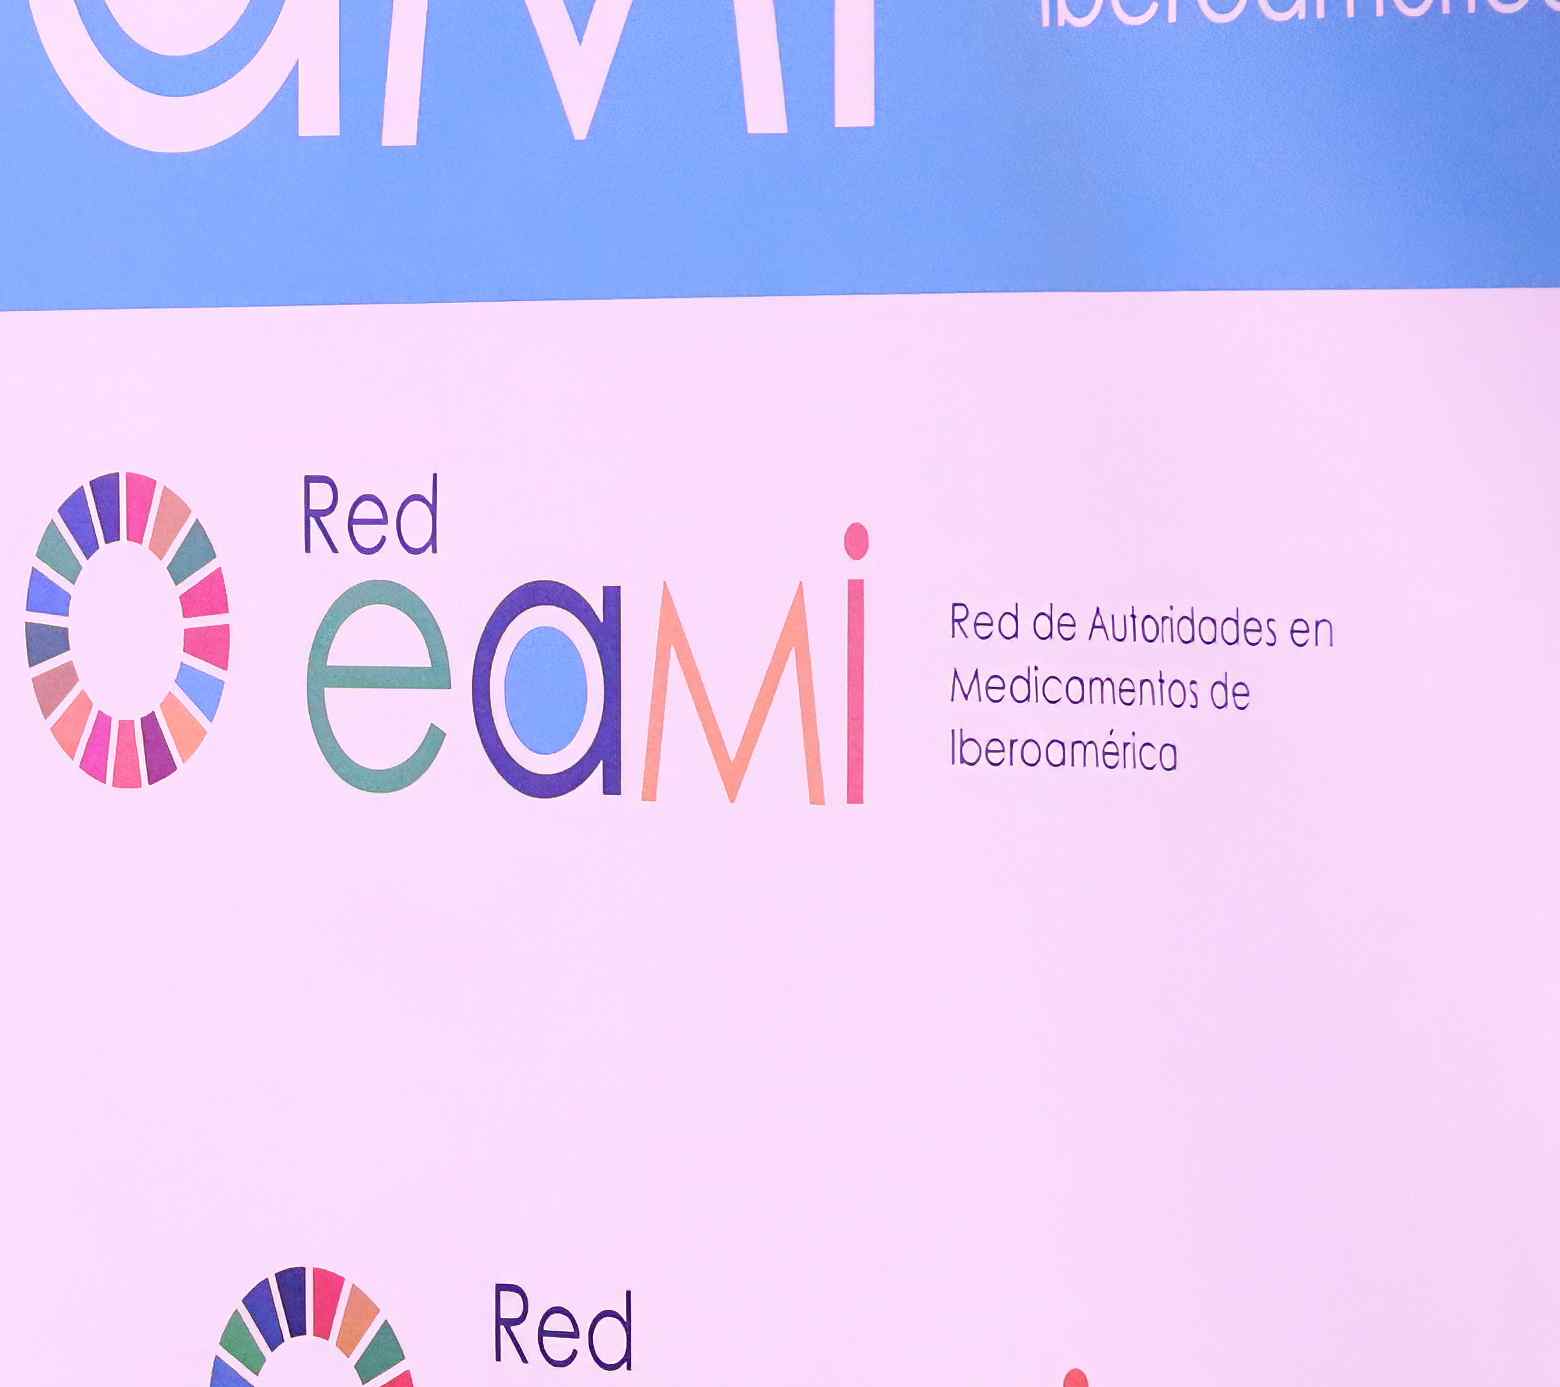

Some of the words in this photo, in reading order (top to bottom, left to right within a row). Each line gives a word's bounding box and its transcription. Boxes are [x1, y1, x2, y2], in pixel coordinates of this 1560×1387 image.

[304, 473, 437, 555] Red
[952, 603, 1017, 642] Red
[1033, 603, 1076, 641] de
[1089, 605, 1276, 646] Autoridades
[1290, 618, 1333, 647] en
[951, 665, 1198, 708] Medicamentos
[1211, 672, 1249, 710] de
[952, 728, 1177, 771] Iberoamérica
[495, 1284, 632, 1371] Red
